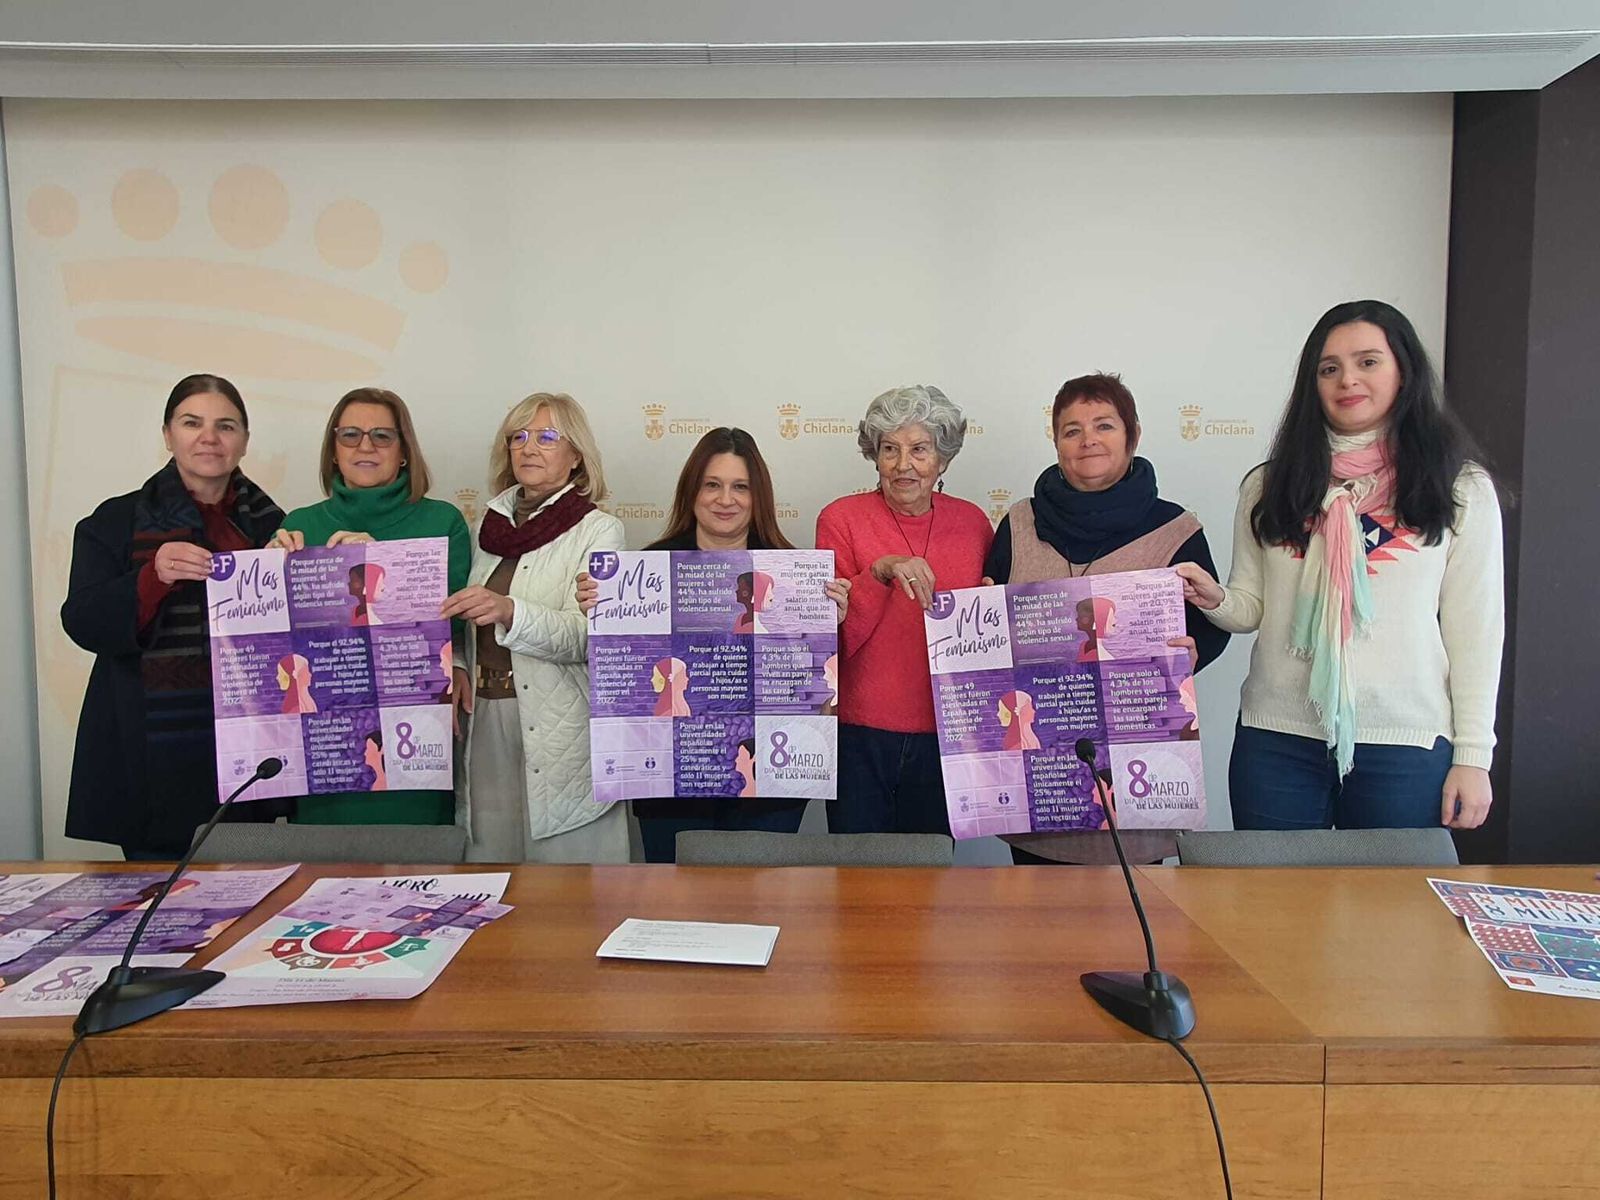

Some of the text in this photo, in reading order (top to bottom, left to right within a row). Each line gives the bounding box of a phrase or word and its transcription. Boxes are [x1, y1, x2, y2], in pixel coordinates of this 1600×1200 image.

[669, 423, 717, 434] Chiclan
[804, 422, 853, 434] Chiclana
[1205, 424, 1254, 434] Chiclana
[616, 508, 664, 518] Chiclana
[677, 563, 701, 572] Porque
[618, 559, 664, 600] Más
[210, 597, 285, 632] Feminismo
[590, 598, 669, 630] Feminismo
[957, 596, 1001, 638] Más
[929, 634, 1010, 670] Feminismo
[1038, 693, 1065, 701] trabajan
[1072, 691, 1095, 699] tiempo
[1144, 696, 1167, 706] pareja
[942, 700, 977, 708] asesinadas
[1036, 701, 1057, 709] parcial
[943, 709, 967, 717] España
[1064, 706, 1091, 715] hijos/as
[1122, 706, 1156, 714] encargan
[396, 722, 414, 759] 8
[413, 744, 443, 758] MARZO
[770, 731, 790, 768] 8
[788, 754, 823, 767] MARZO
[1032, 763, 1080, 771] universidades
[1032, 772, 1067, 781] españolas
[1128, 760, 1151, 798] 8
[1149, 781, 1189, 796] MARZO
[32, 966, 93, 992] 8
